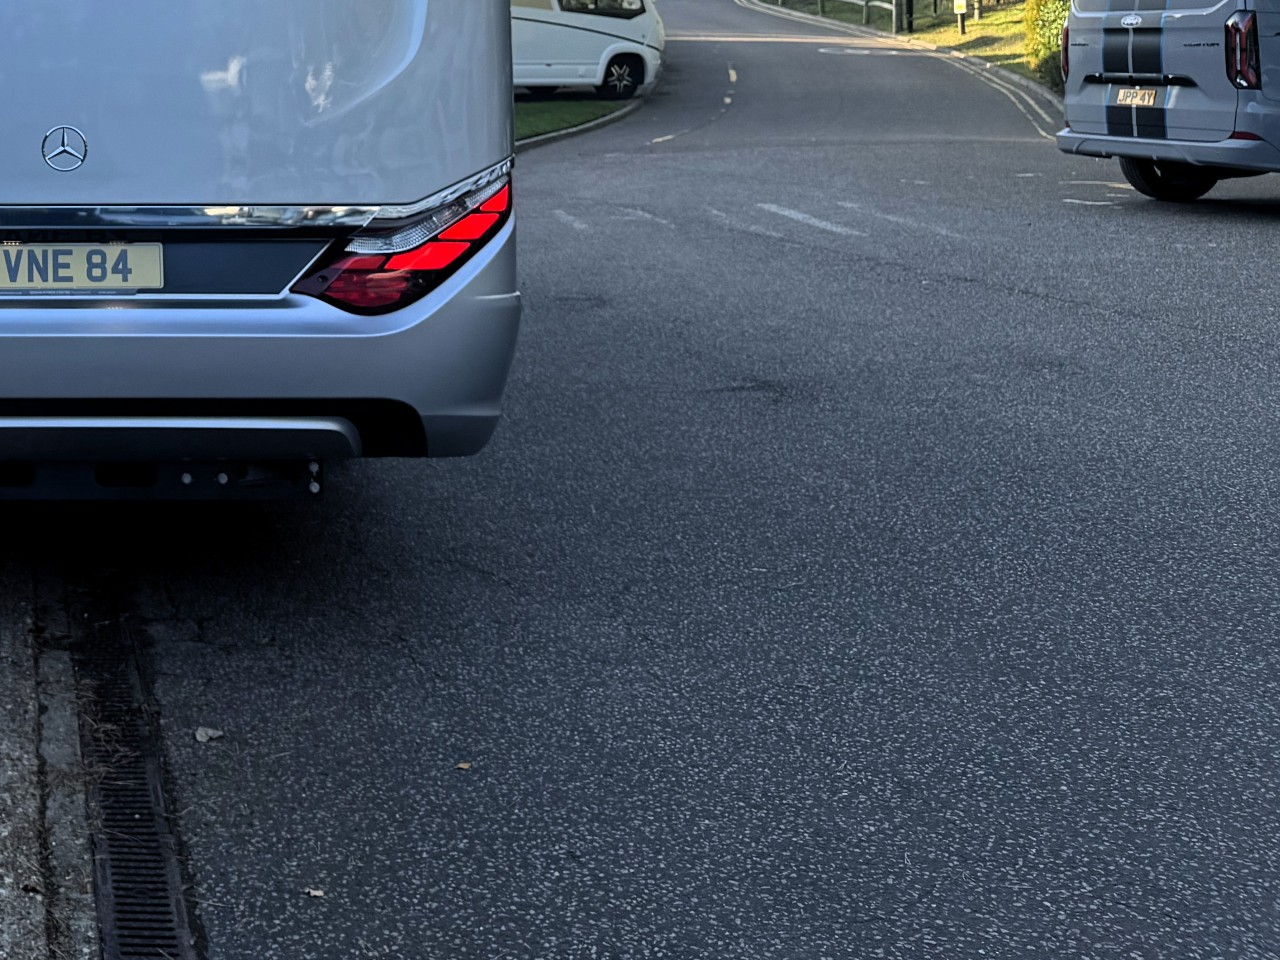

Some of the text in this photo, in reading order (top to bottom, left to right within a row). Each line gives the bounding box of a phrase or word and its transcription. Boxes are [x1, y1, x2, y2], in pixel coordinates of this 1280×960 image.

[1119, 90, 1155, 104] JPP 4Y
[3, 249, 133, 283] VNE 84
